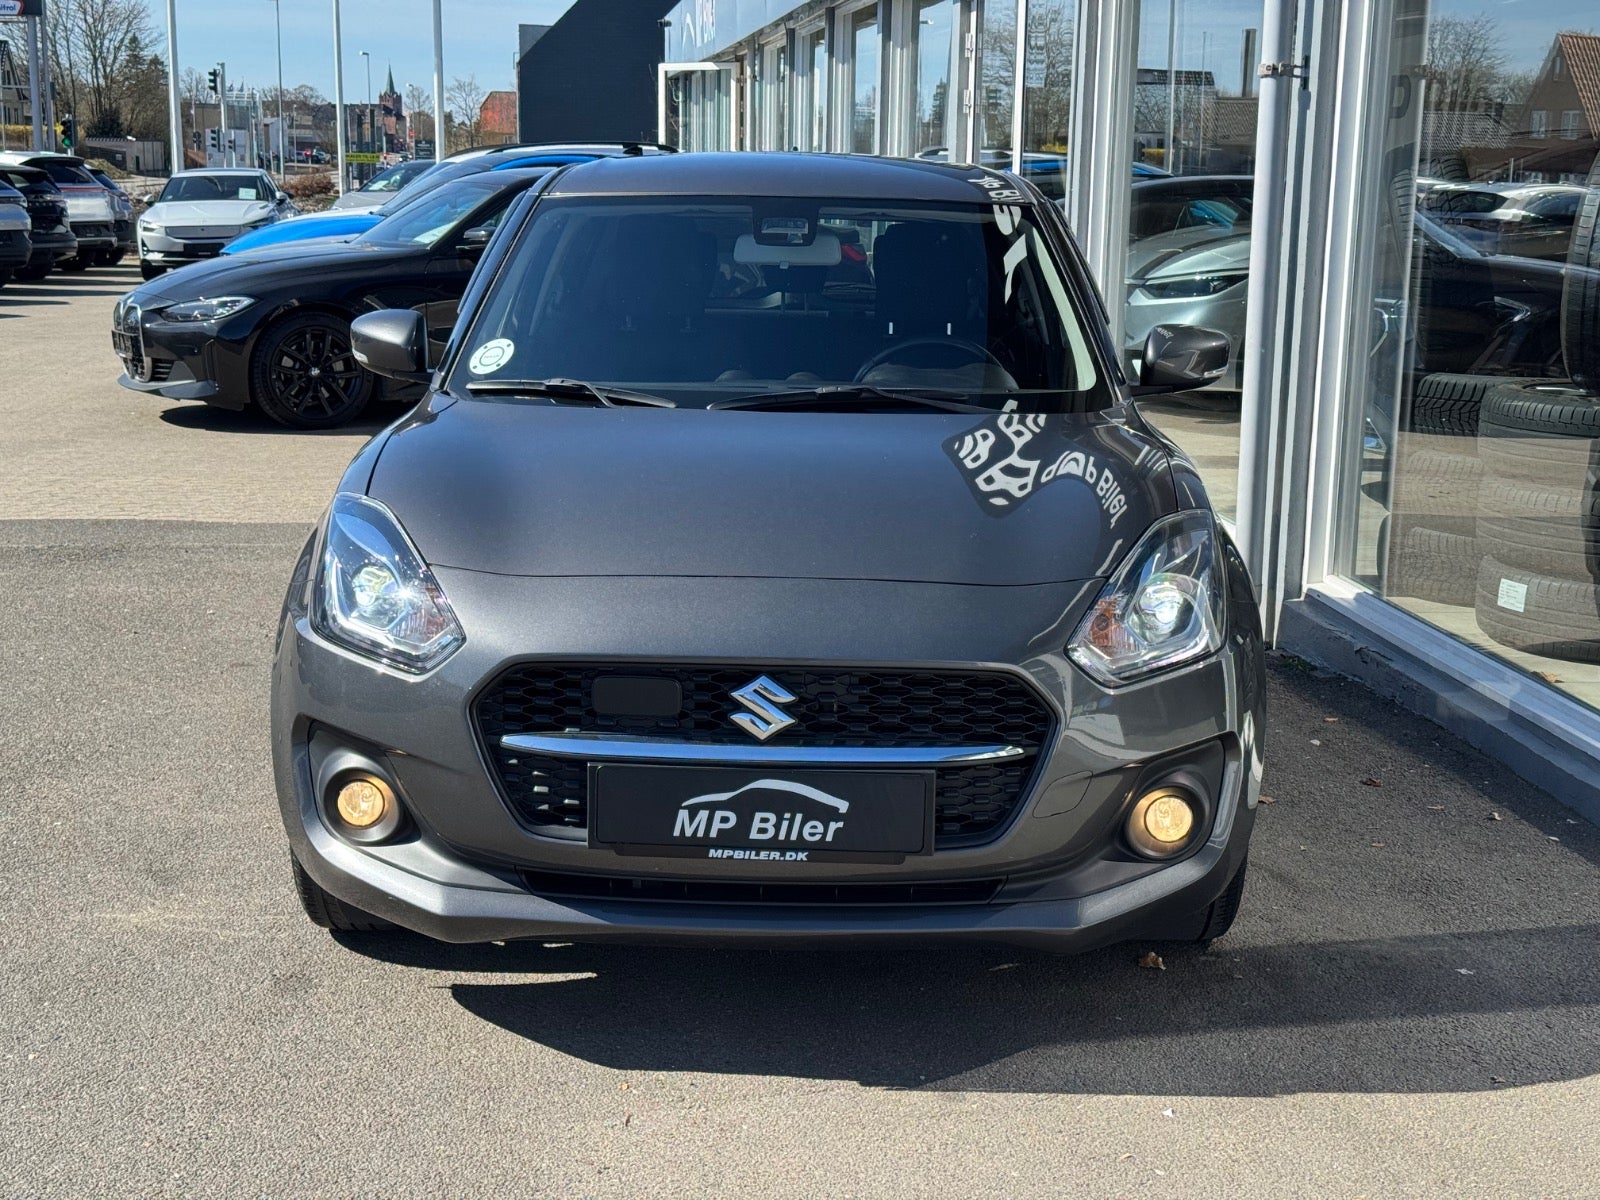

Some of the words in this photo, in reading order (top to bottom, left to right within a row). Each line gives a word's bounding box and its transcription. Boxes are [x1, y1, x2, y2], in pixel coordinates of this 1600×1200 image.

[672, 808, 738, 839] MP
[748, 810, 844, 843] Biler
[708, 849, 808, 861] MPBILER.DK
